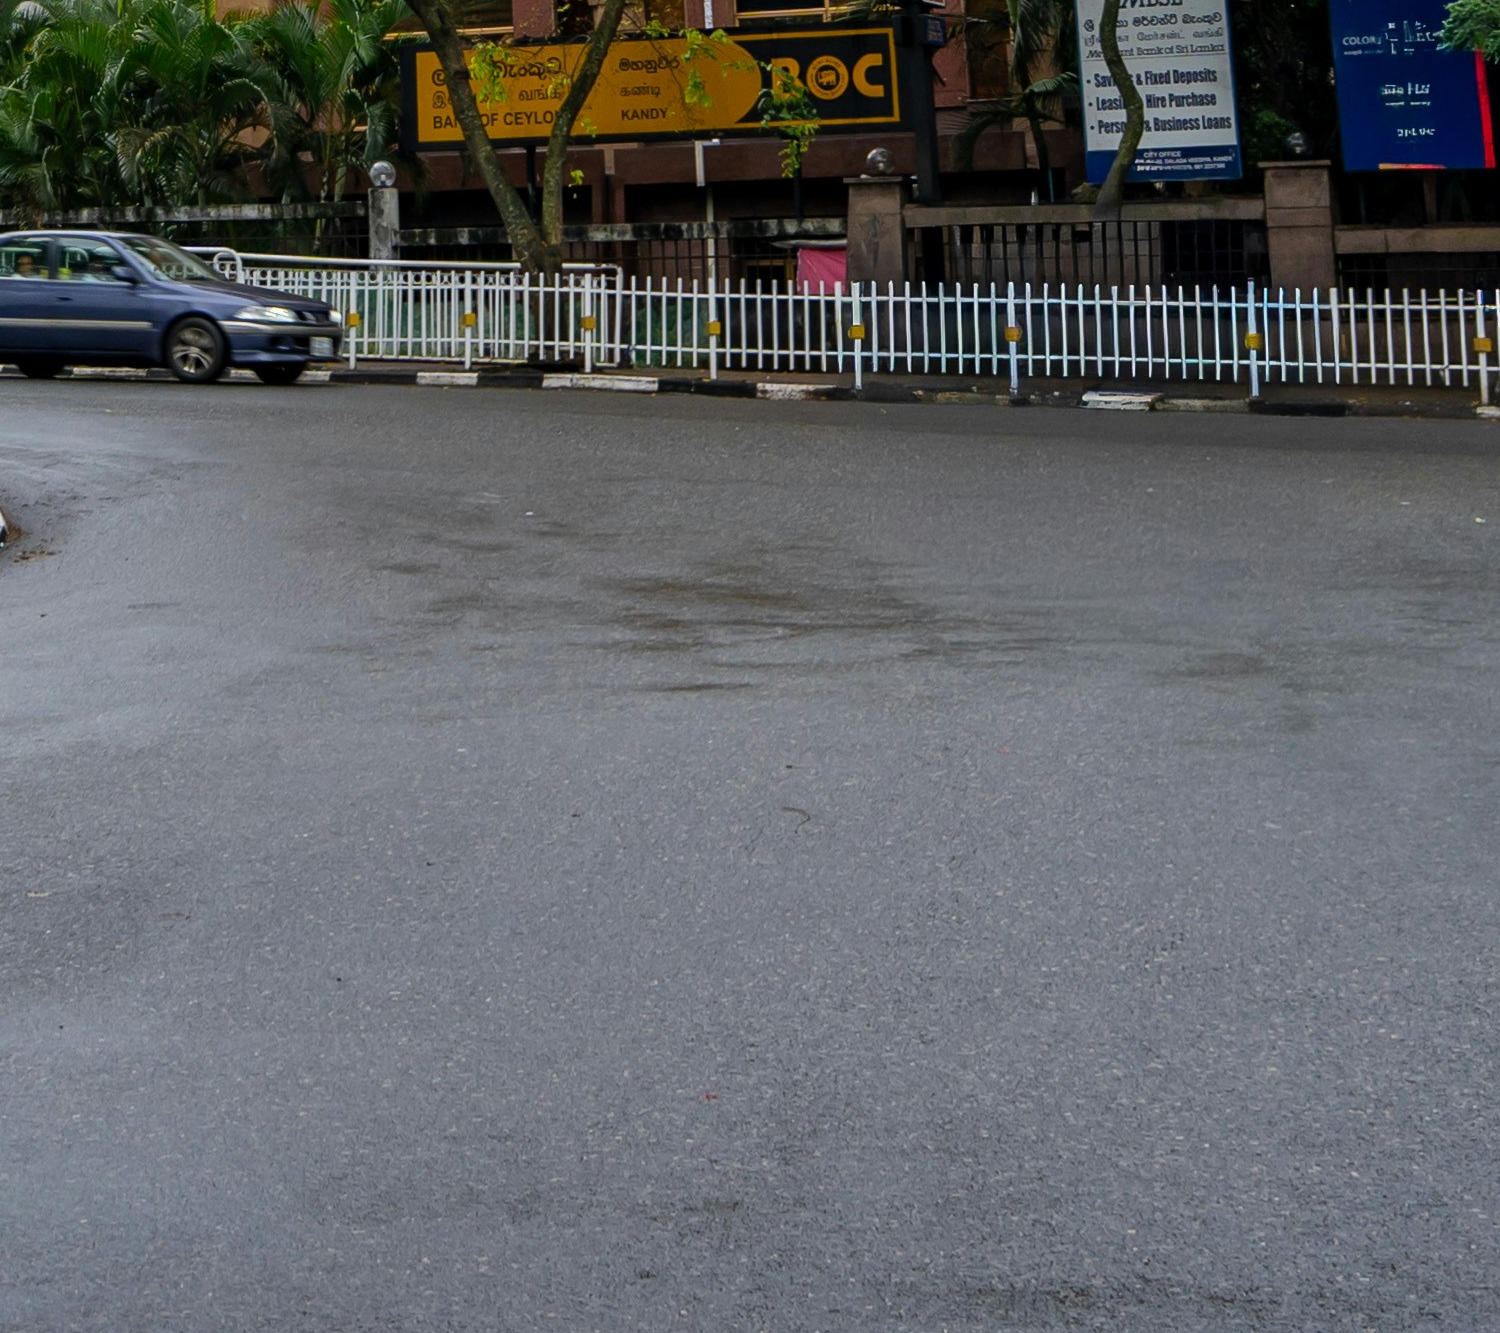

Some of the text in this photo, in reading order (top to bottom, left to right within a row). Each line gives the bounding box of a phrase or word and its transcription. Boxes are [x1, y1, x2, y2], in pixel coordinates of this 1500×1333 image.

[1137, 46, 1163, 56] Bank
[1164, 46, 1174, 54] of
[1176, 45, 1188, 53] Sri
[1190, 43, 1225, 53] Lanka
[771, 53, 884, 101] BOC
[1135, 74, 1144, 85] &
[1144, 70, 1171, 85] Fixed
[1172, 68, 1217, 86] Deposits
[1145, 93, 1167, 109] Hire
[1168, 92, 1217, 108] Purchase
[503, 110, 561, 126] CEYLO
[621, 108, 668, 121] KANDY
[1153, 116, 1200, 132] Business
[1202, 115, 1232, 130] Loans
